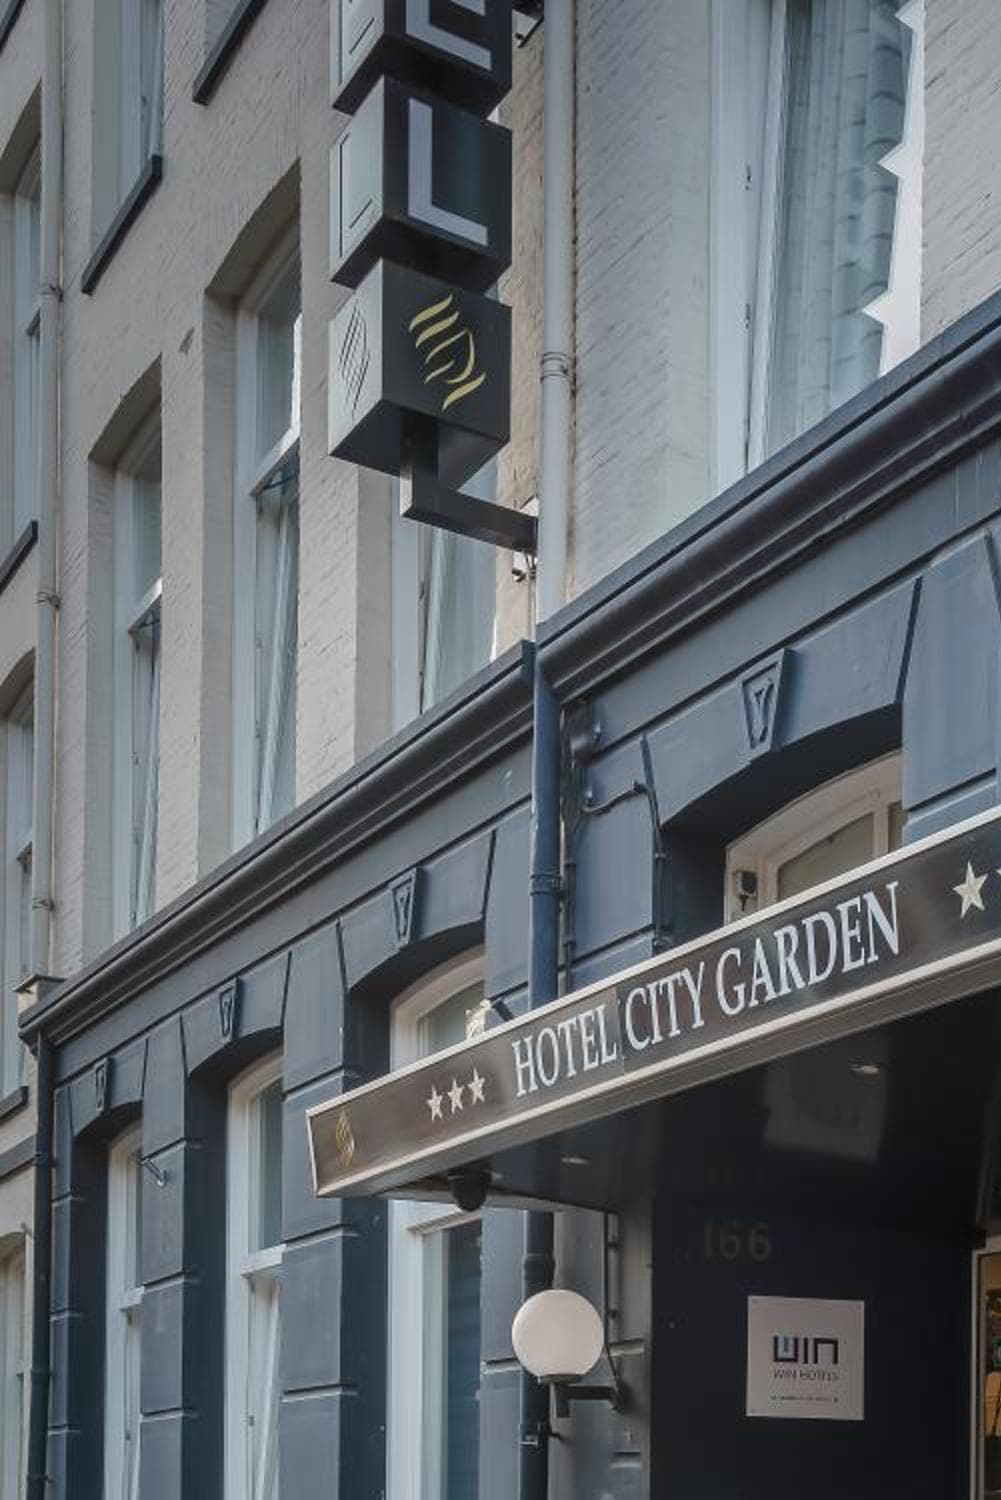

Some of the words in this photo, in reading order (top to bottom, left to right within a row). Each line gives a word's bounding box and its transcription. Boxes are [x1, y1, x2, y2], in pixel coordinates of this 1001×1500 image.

[511, 1003, 618, 1098] HOTEL
[625, 960, 705, 1050] CITY
[716, 881, 899, 1016] GARDEN
